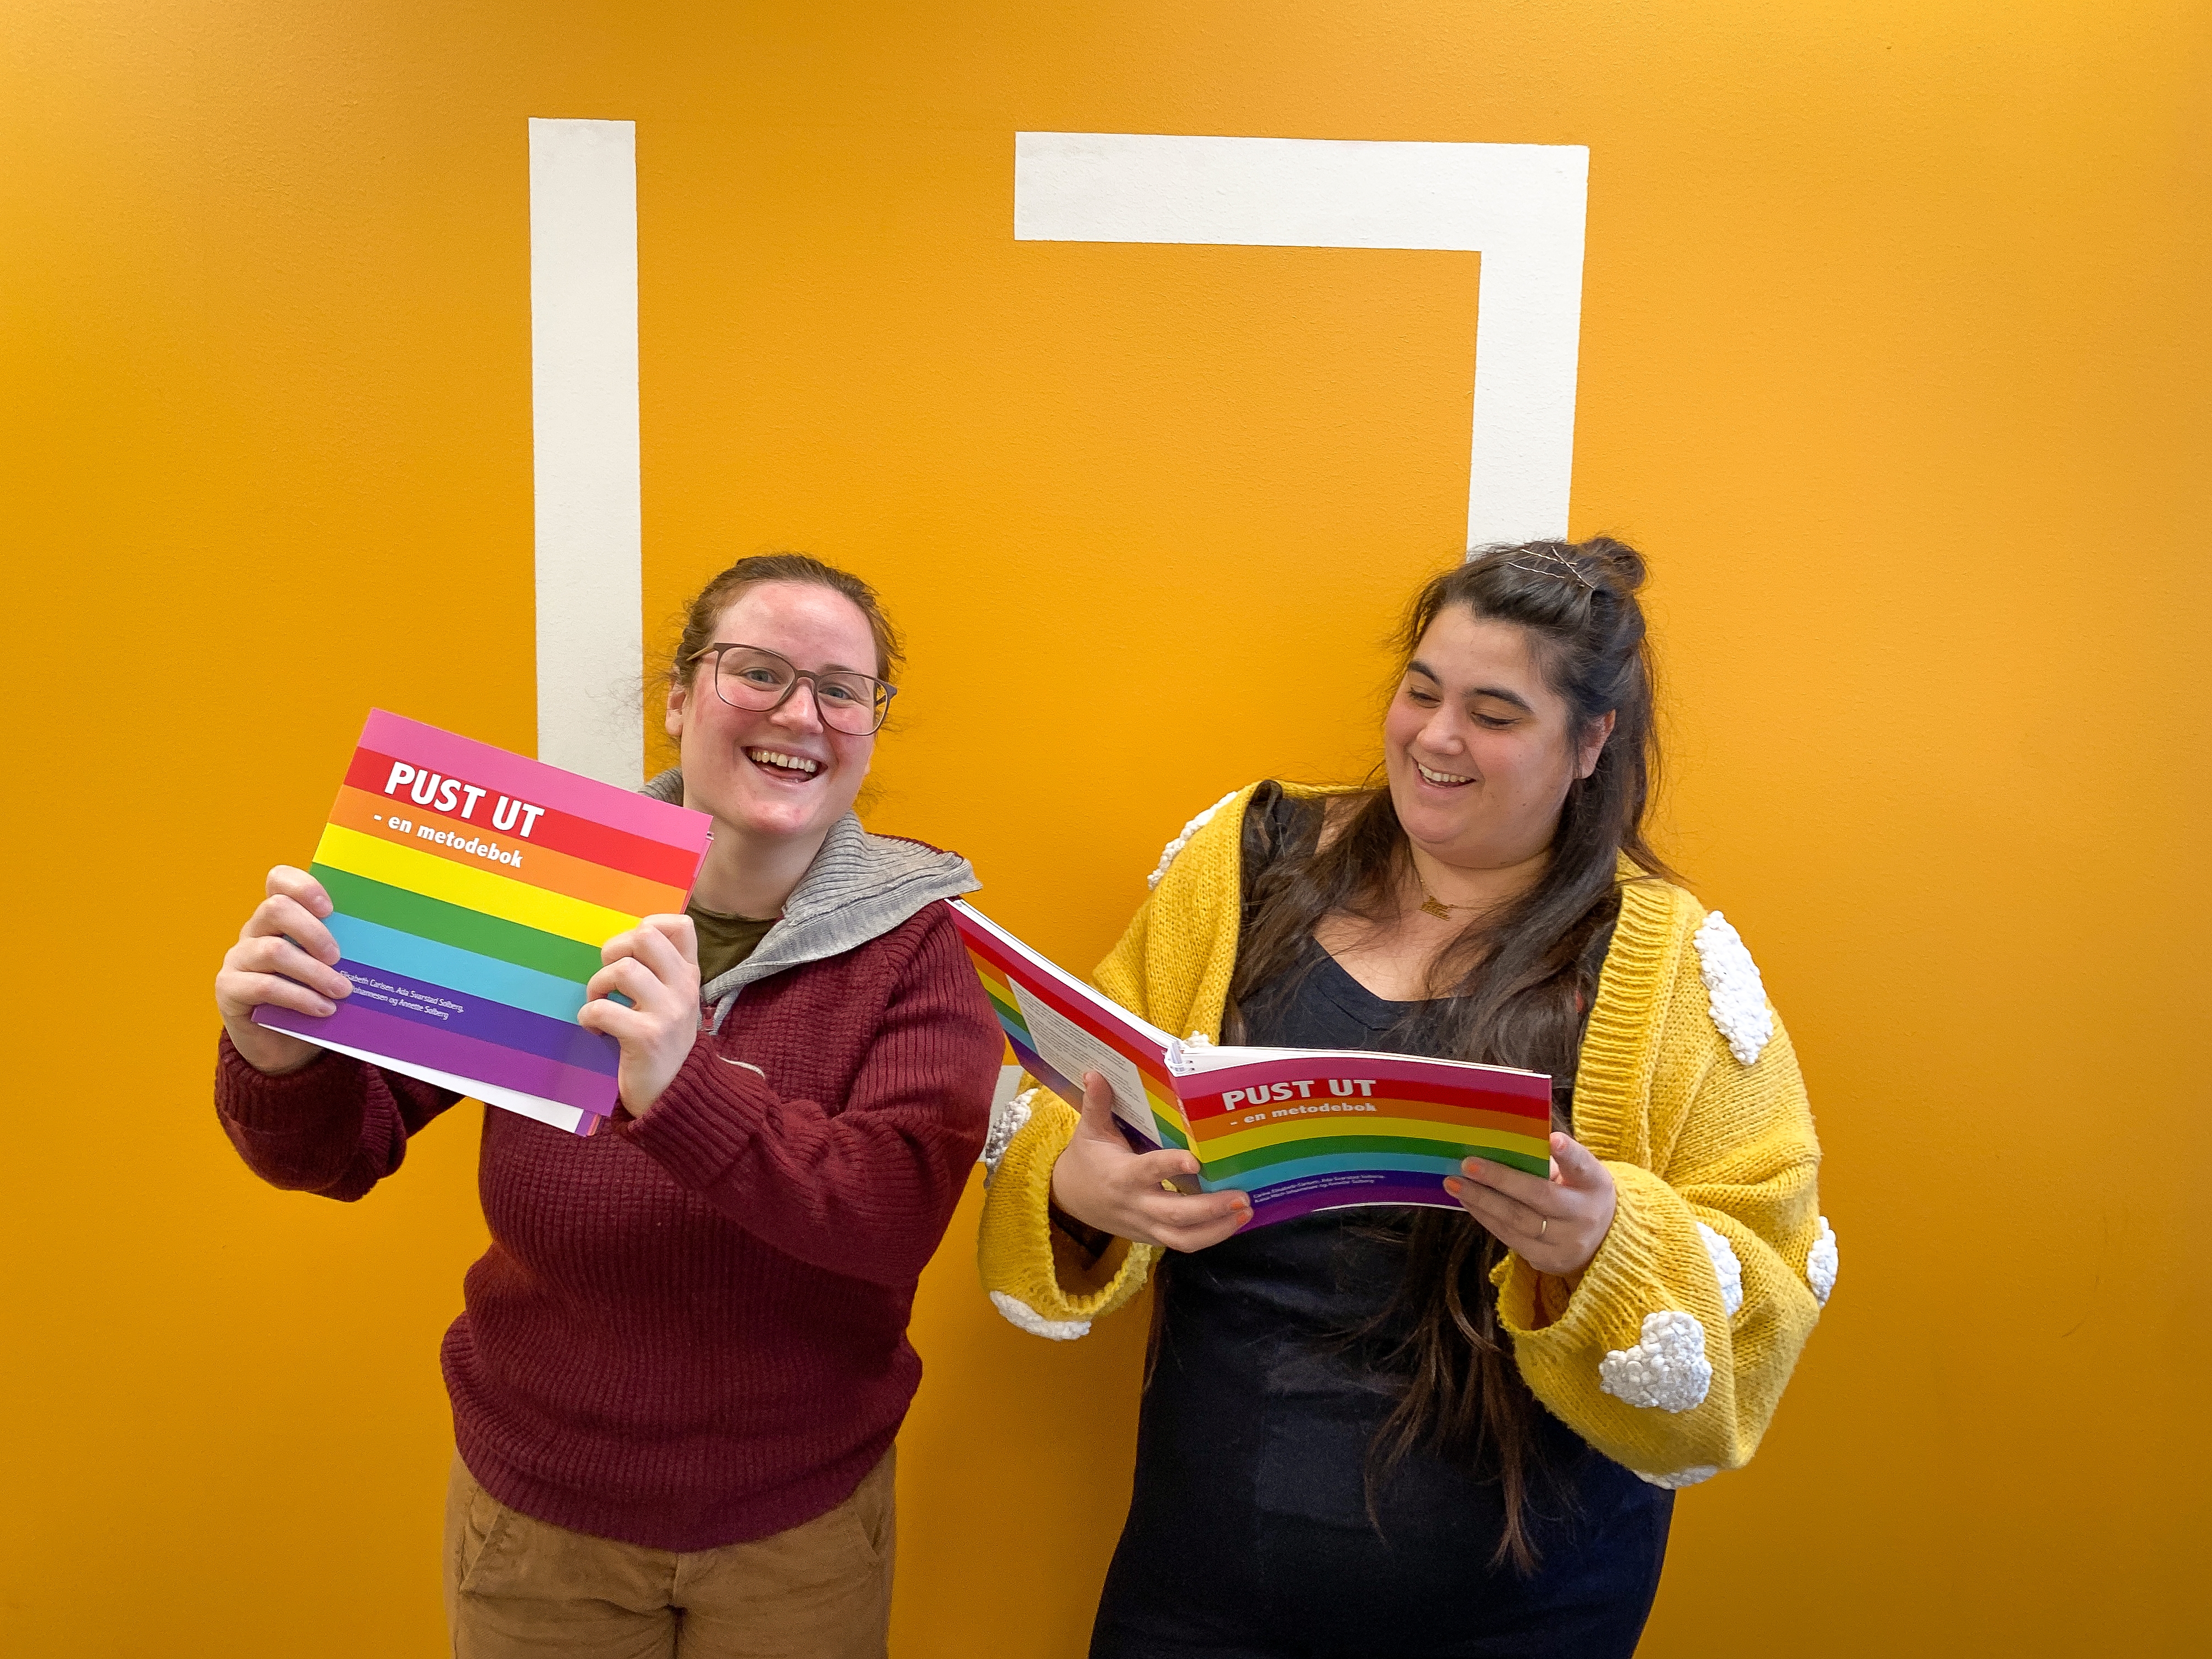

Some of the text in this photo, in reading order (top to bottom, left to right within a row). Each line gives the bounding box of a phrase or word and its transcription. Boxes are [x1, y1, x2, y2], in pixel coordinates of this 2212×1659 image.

[385, 761, 545, 838] PUST UT
[387, 816, 413, 833] en
[417, 825, 524, 868] metodebok
[388, 997, 398, 1006] og
[1222, 1079, 1377, 1111] PUST UT
[1243, 1113, 1266, 1123] en
[1271, 1102, 1378, 1118] metodebok
